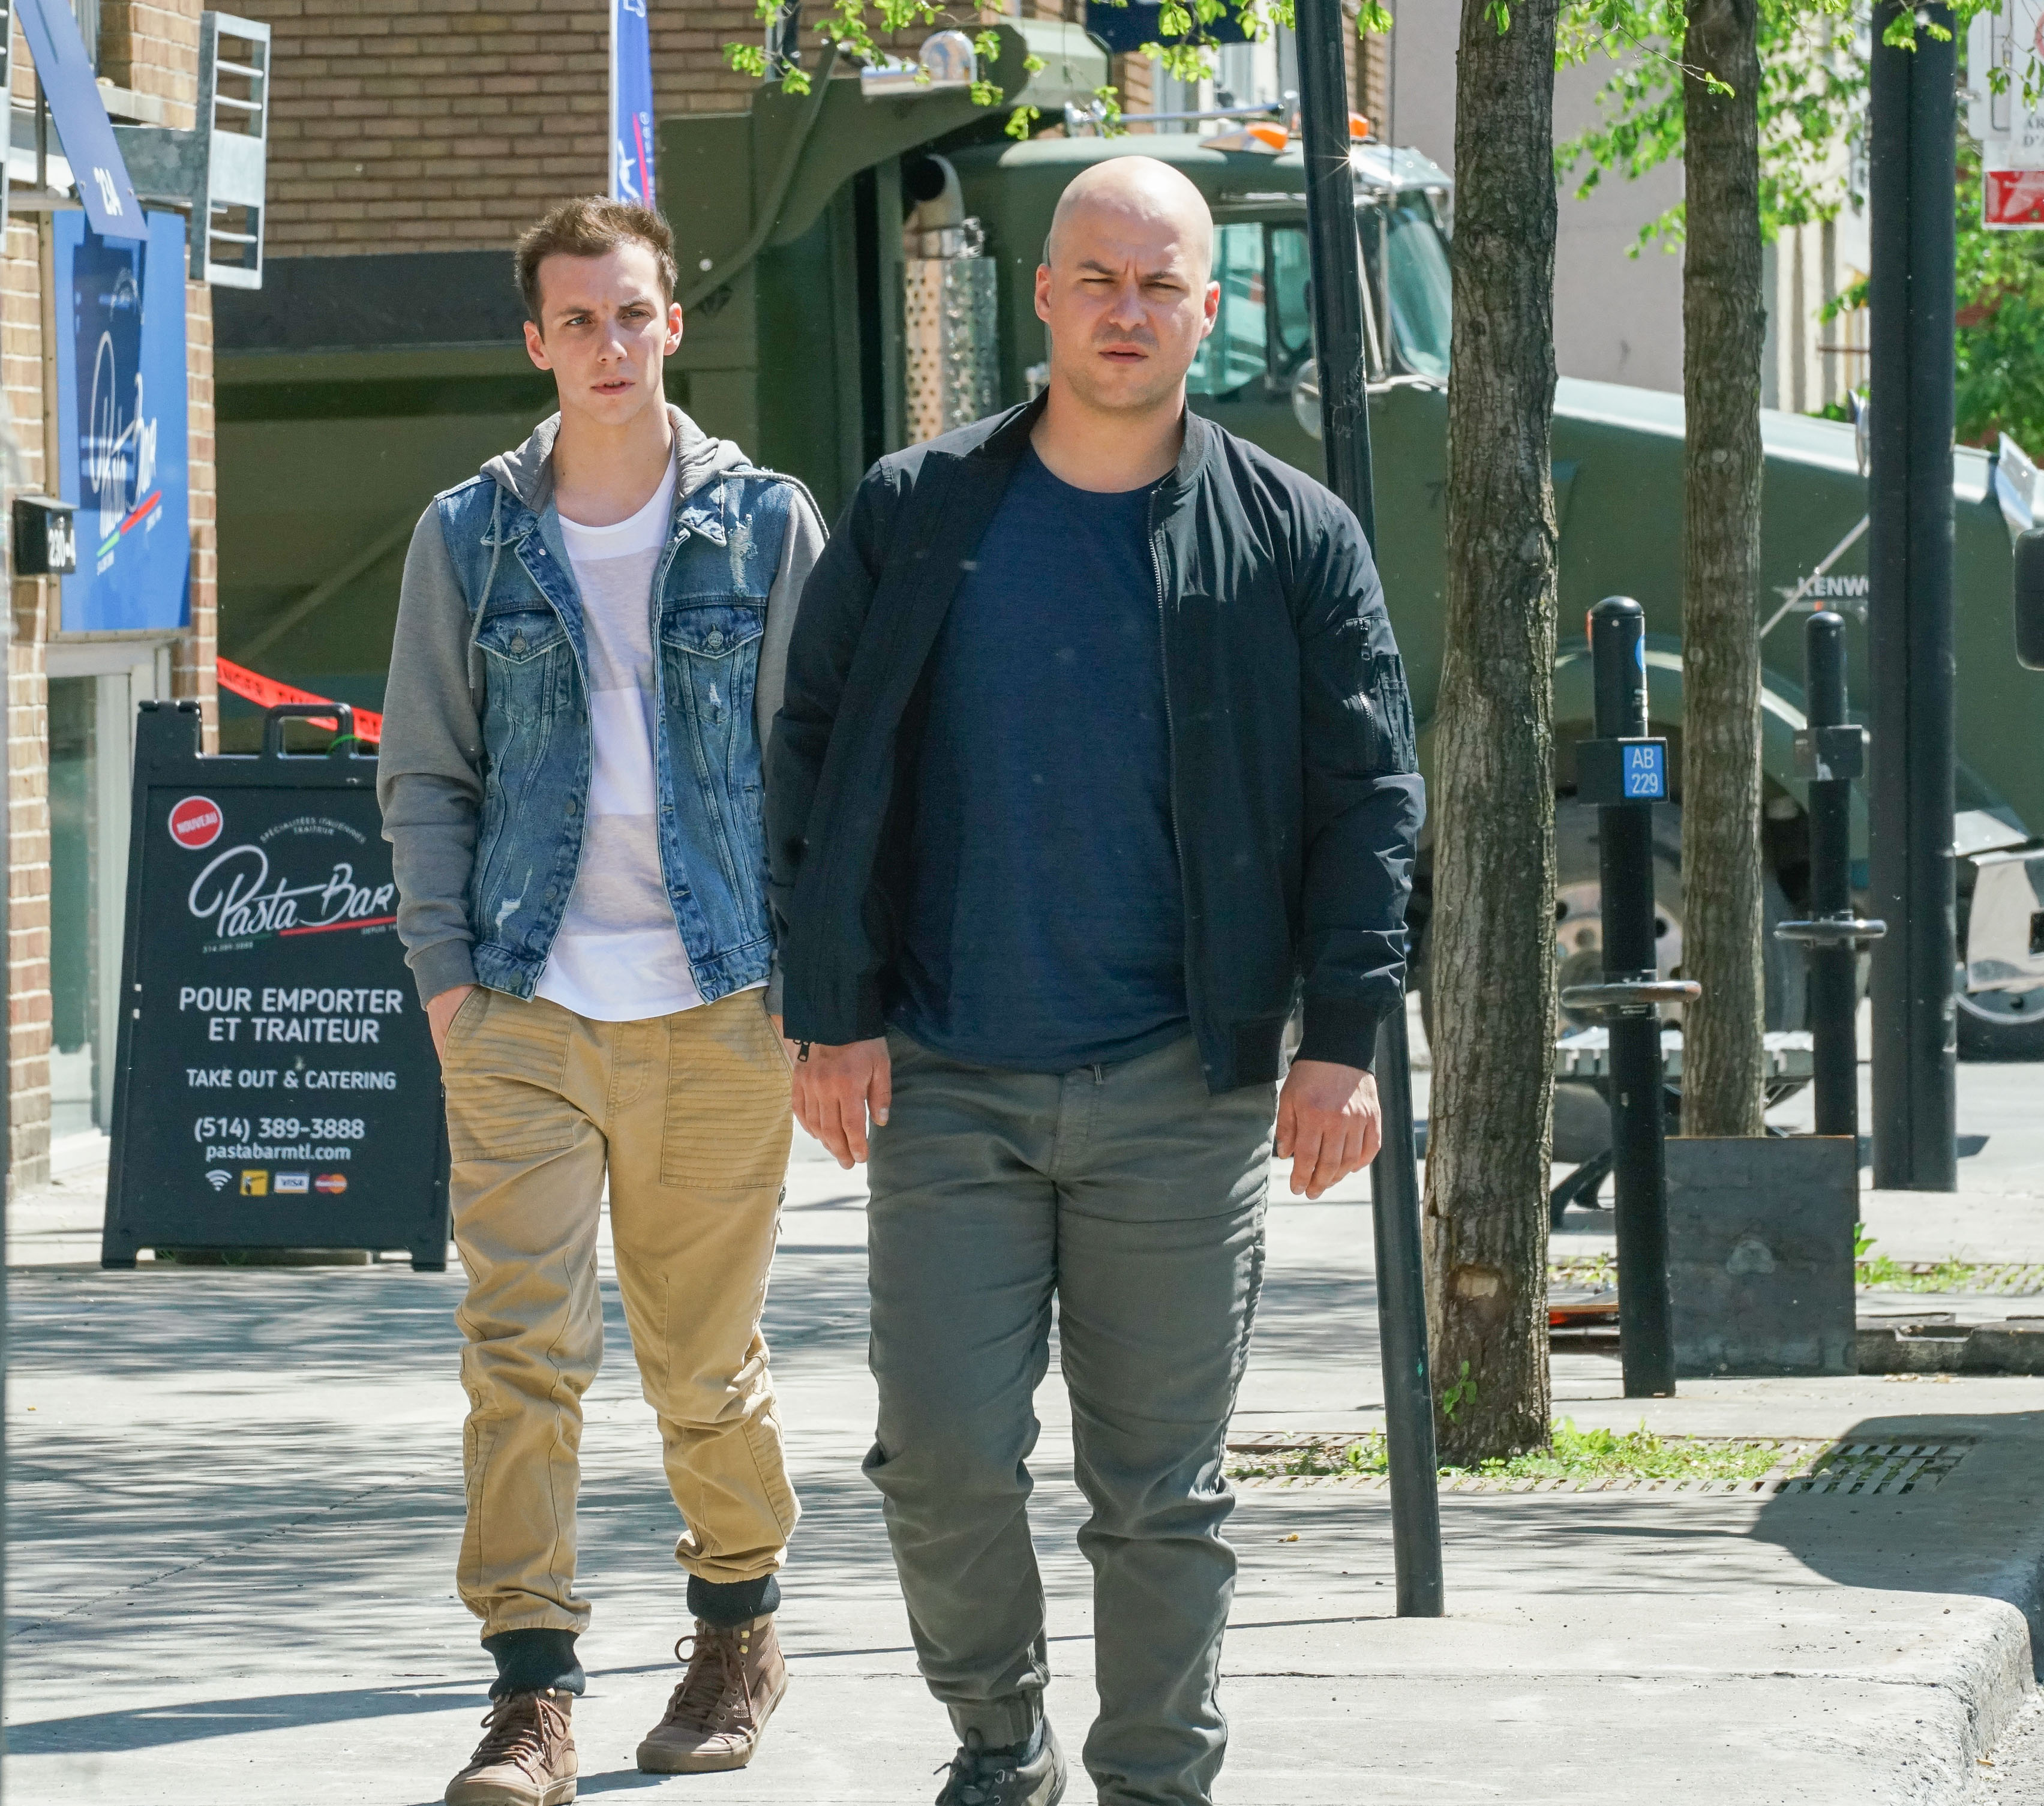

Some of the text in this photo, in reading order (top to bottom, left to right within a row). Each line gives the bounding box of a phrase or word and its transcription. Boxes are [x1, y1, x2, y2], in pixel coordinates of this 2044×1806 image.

[1797, 575, 1869, 597] KENW
[1632, 748, 1654, 769] AB
[1632, 772, 1659, 794] 229
[176, 811, 218, 835] NOUVEAU
[188, 844, 327, 937] Pasta
[179, 987, 403, 1014] POUR EMPORTER
[209, 1017, 380, 1043] ET TRAITEUR
[186, 1069, 397, 1090] TAKE OUT & CATERING
[194, 1117, 365, 1142] (514) 389-3888
[205, 1143, 351, 1162] pastabarmtl.com
